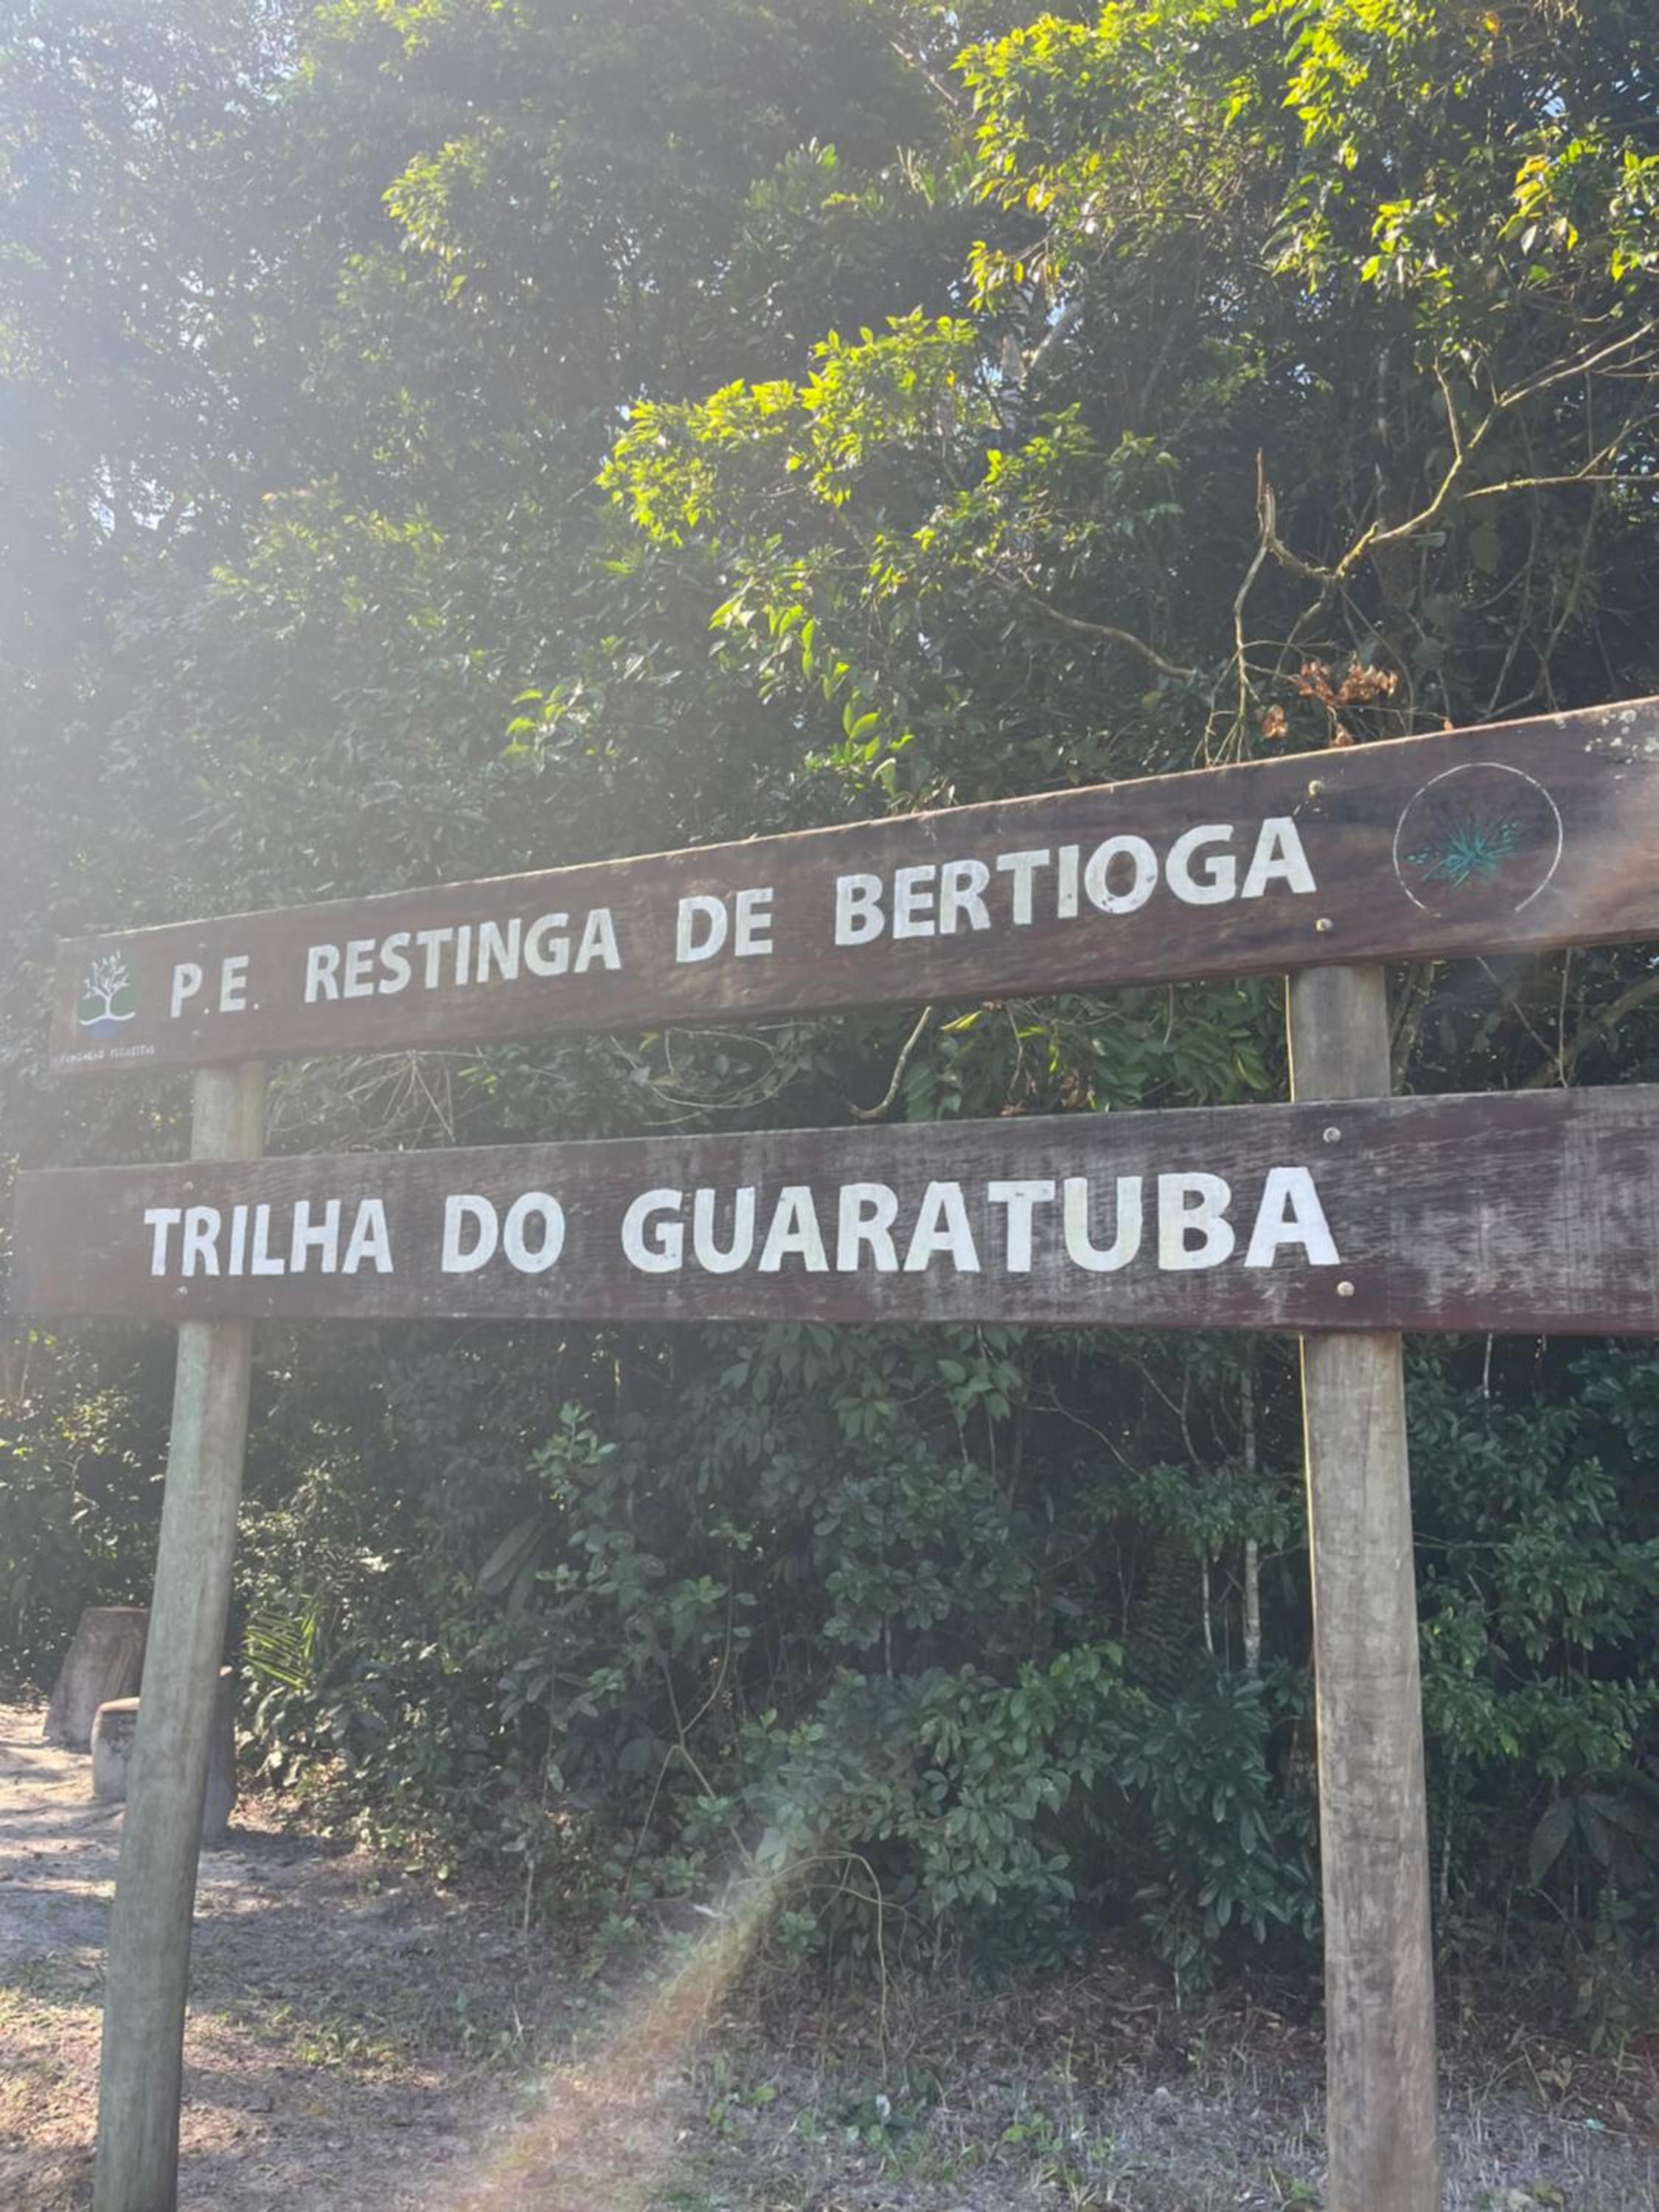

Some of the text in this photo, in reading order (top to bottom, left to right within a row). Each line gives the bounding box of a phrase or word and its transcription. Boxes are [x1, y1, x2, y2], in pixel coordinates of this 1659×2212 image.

[304, 907, 622, 1004] RESTINGA
[675, 887, 774, 963] DE
[834, 815, 1318, 946] BERTIOGA
[144, 1165, 1342, 1276] TRILHA DO GUARATUBA
